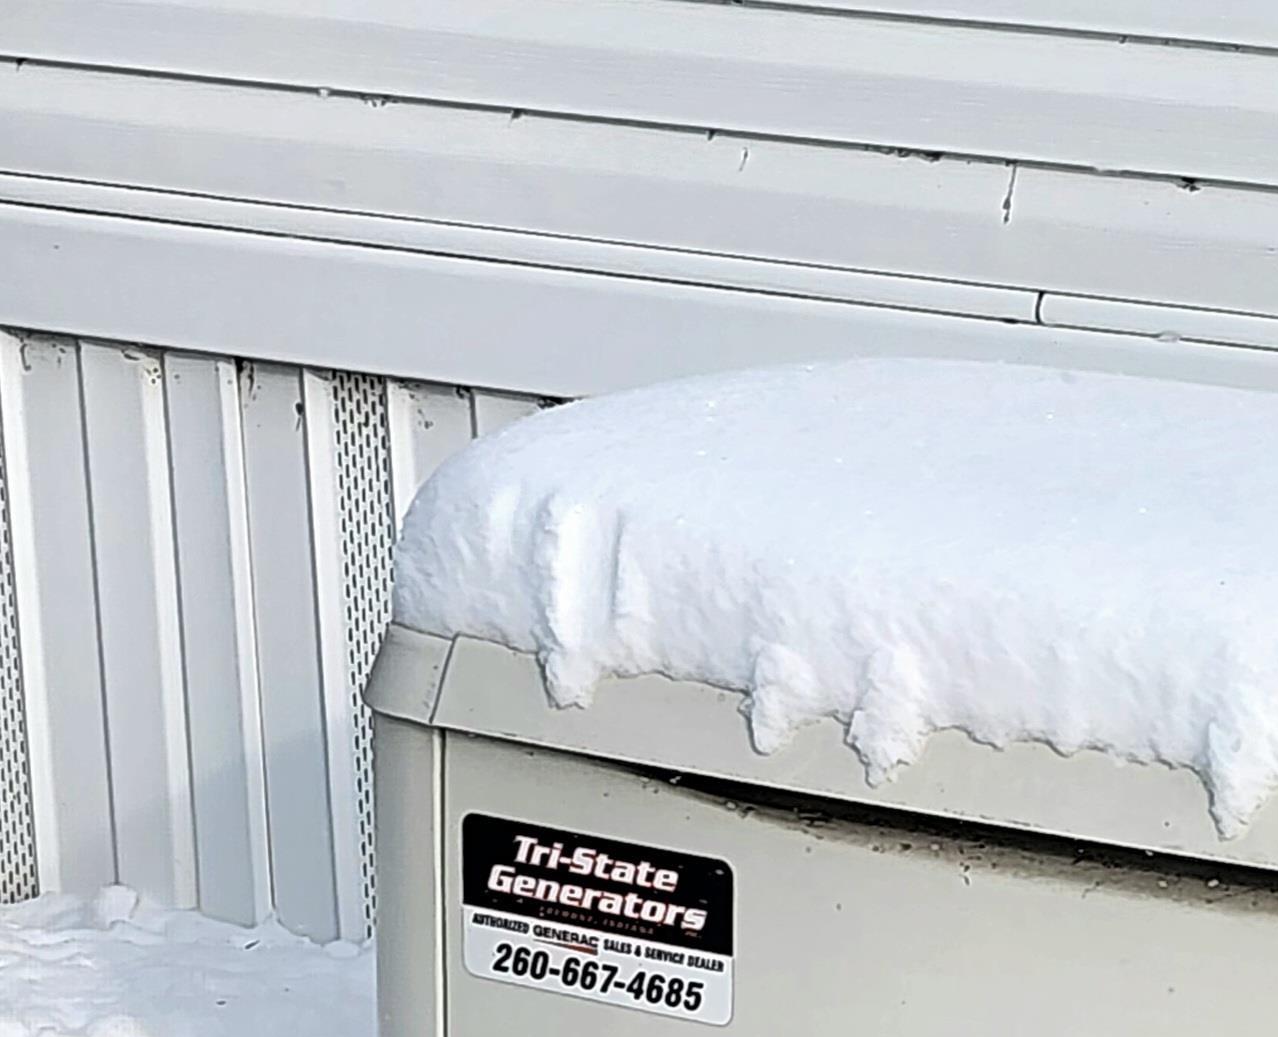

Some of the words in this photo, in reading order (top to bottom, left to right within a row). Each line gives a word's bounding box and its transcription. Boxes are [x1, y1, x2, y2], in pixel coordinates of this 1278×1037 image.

[513, 835, 679, 892] Tri-State
[487, 864, 708, 931] Generators
[472, 912, 530, 935] AUTHORIZED
[532, 924, 599, 949] GENERAC
[603, 938, 632, 955] SALES
[634, 943, 642, 957] &
[644, 946, 686, 965] SERVICE
[687, 951, 725, 973] DEALER
[492, 942, 704, 1011] 260-667-4685
